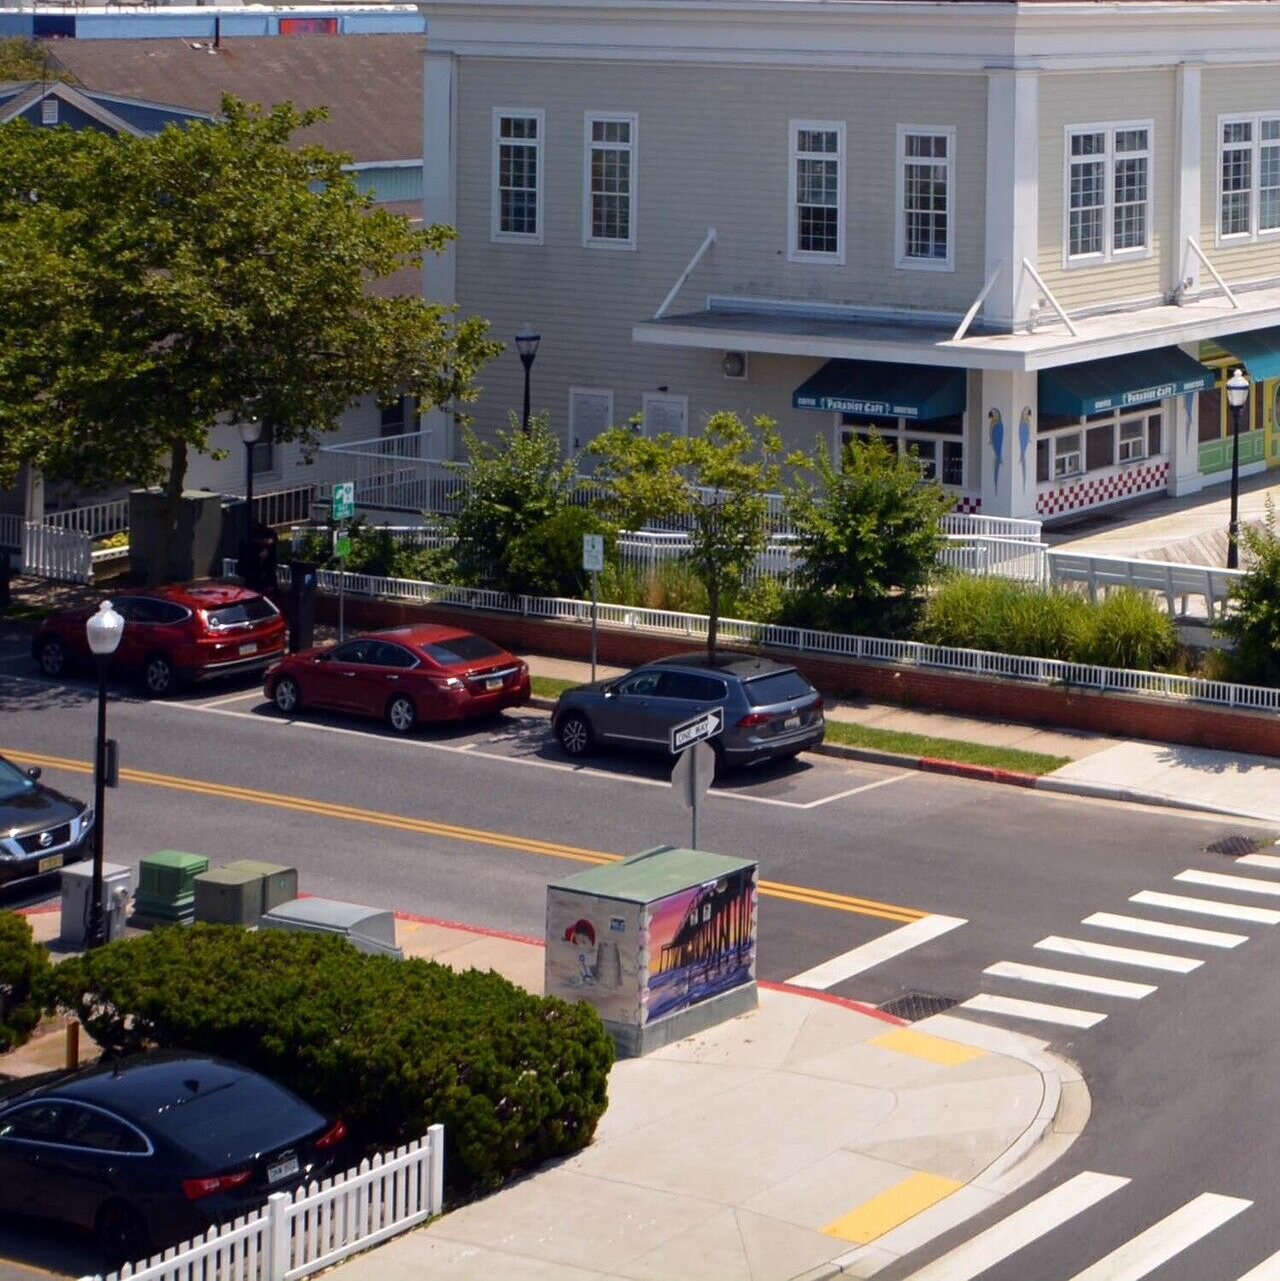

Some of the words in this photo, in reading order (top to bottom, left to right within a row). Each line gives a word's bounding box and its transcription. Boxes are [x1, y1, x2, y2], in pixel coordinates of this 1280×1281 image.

[1127, 390, 1156, 403] PARADISE
[826, 398, 863, 412] PARADISE
[677, 729, 691, 743] ONE
[695, 721, 708, 734] WAY
